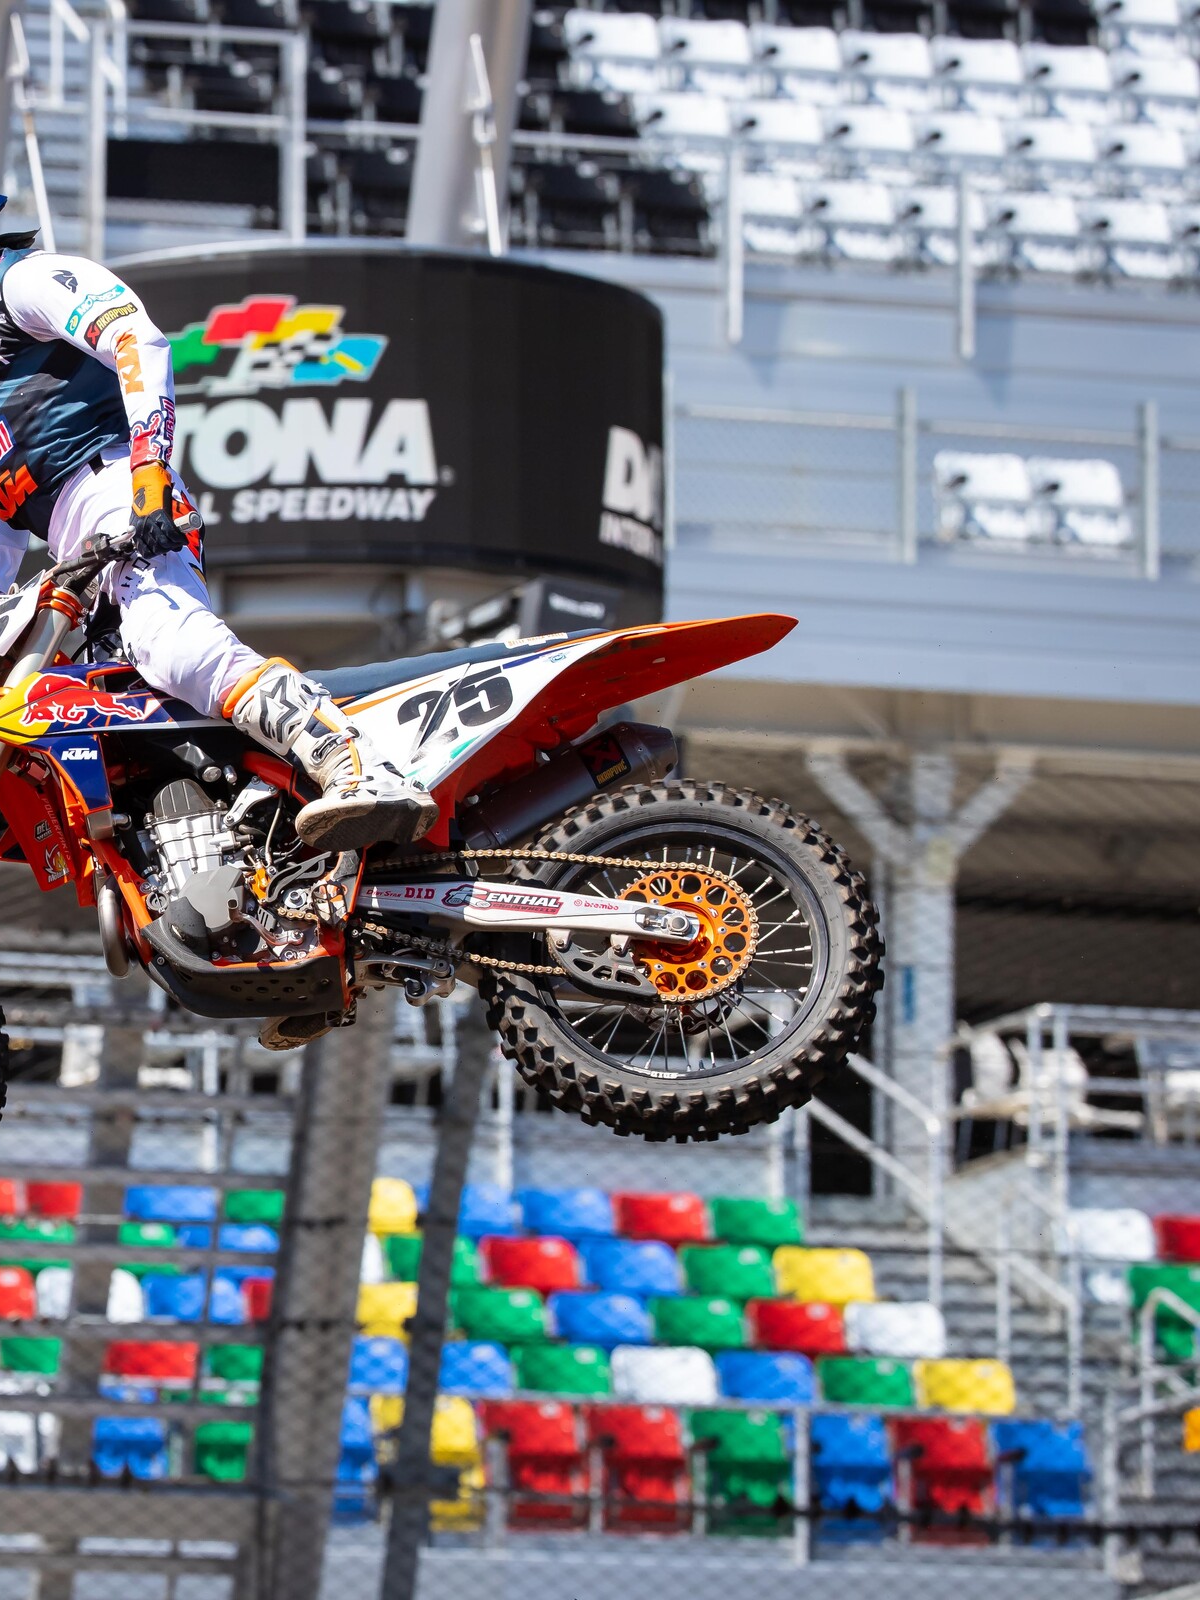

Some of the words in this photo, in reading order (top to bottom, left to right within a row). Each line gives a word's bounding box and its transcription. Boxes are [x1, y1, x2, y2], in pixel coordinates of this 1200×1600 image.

[231, 488, 437, 523] SPEEDWAY
[396, 665, 514, 765] 25
[61, 748, 98, 761] KTM
[583, 900, 620, 912] brembo
